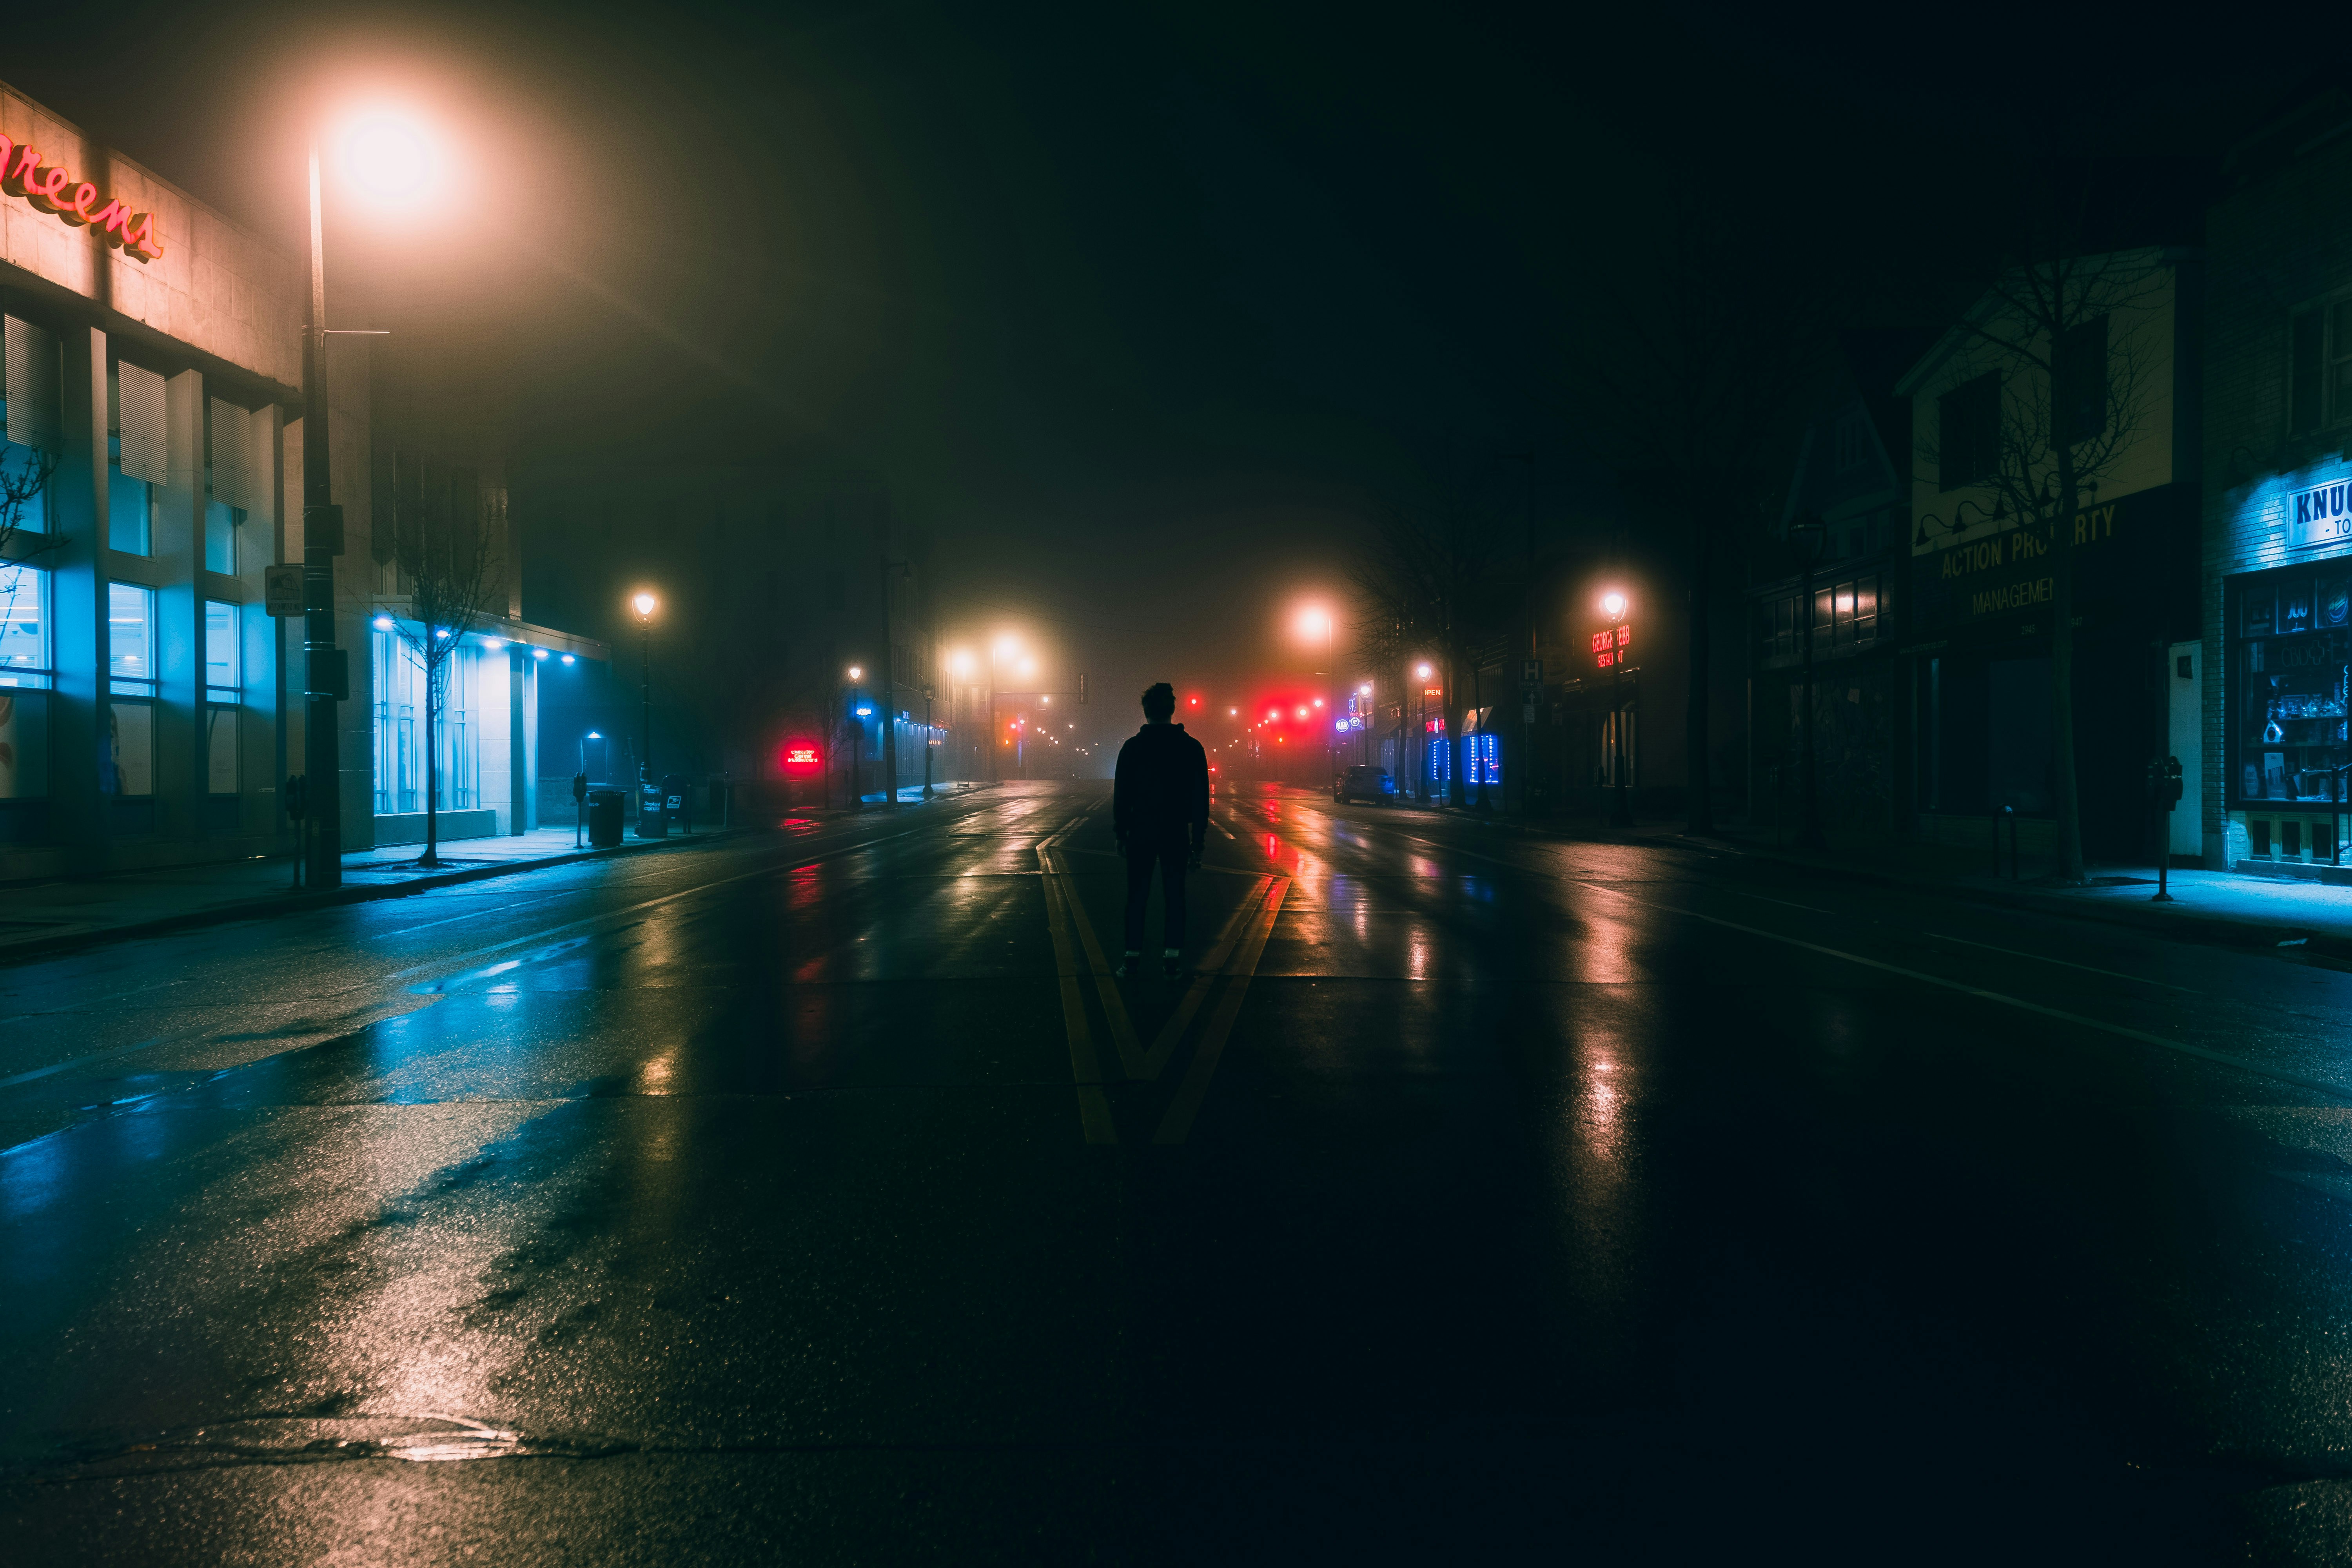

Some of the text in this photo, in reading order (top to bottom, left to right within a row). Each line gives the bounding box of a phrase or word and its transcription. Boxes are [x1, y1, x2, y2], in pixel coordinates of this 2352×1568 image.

[1942, 505, 2116, 579] ACTION PRORTY
[1973, 577, 2054, 615] MANAGEMEN
[2021, 624, 2035, 635] 2945
[2071, 617, 2082, 627] 947
[1592, 624, 1630, 653] GEORGE EBB
[2281, 646, 2308, 667] CBD
[1524, 662, 1539, 679] H
